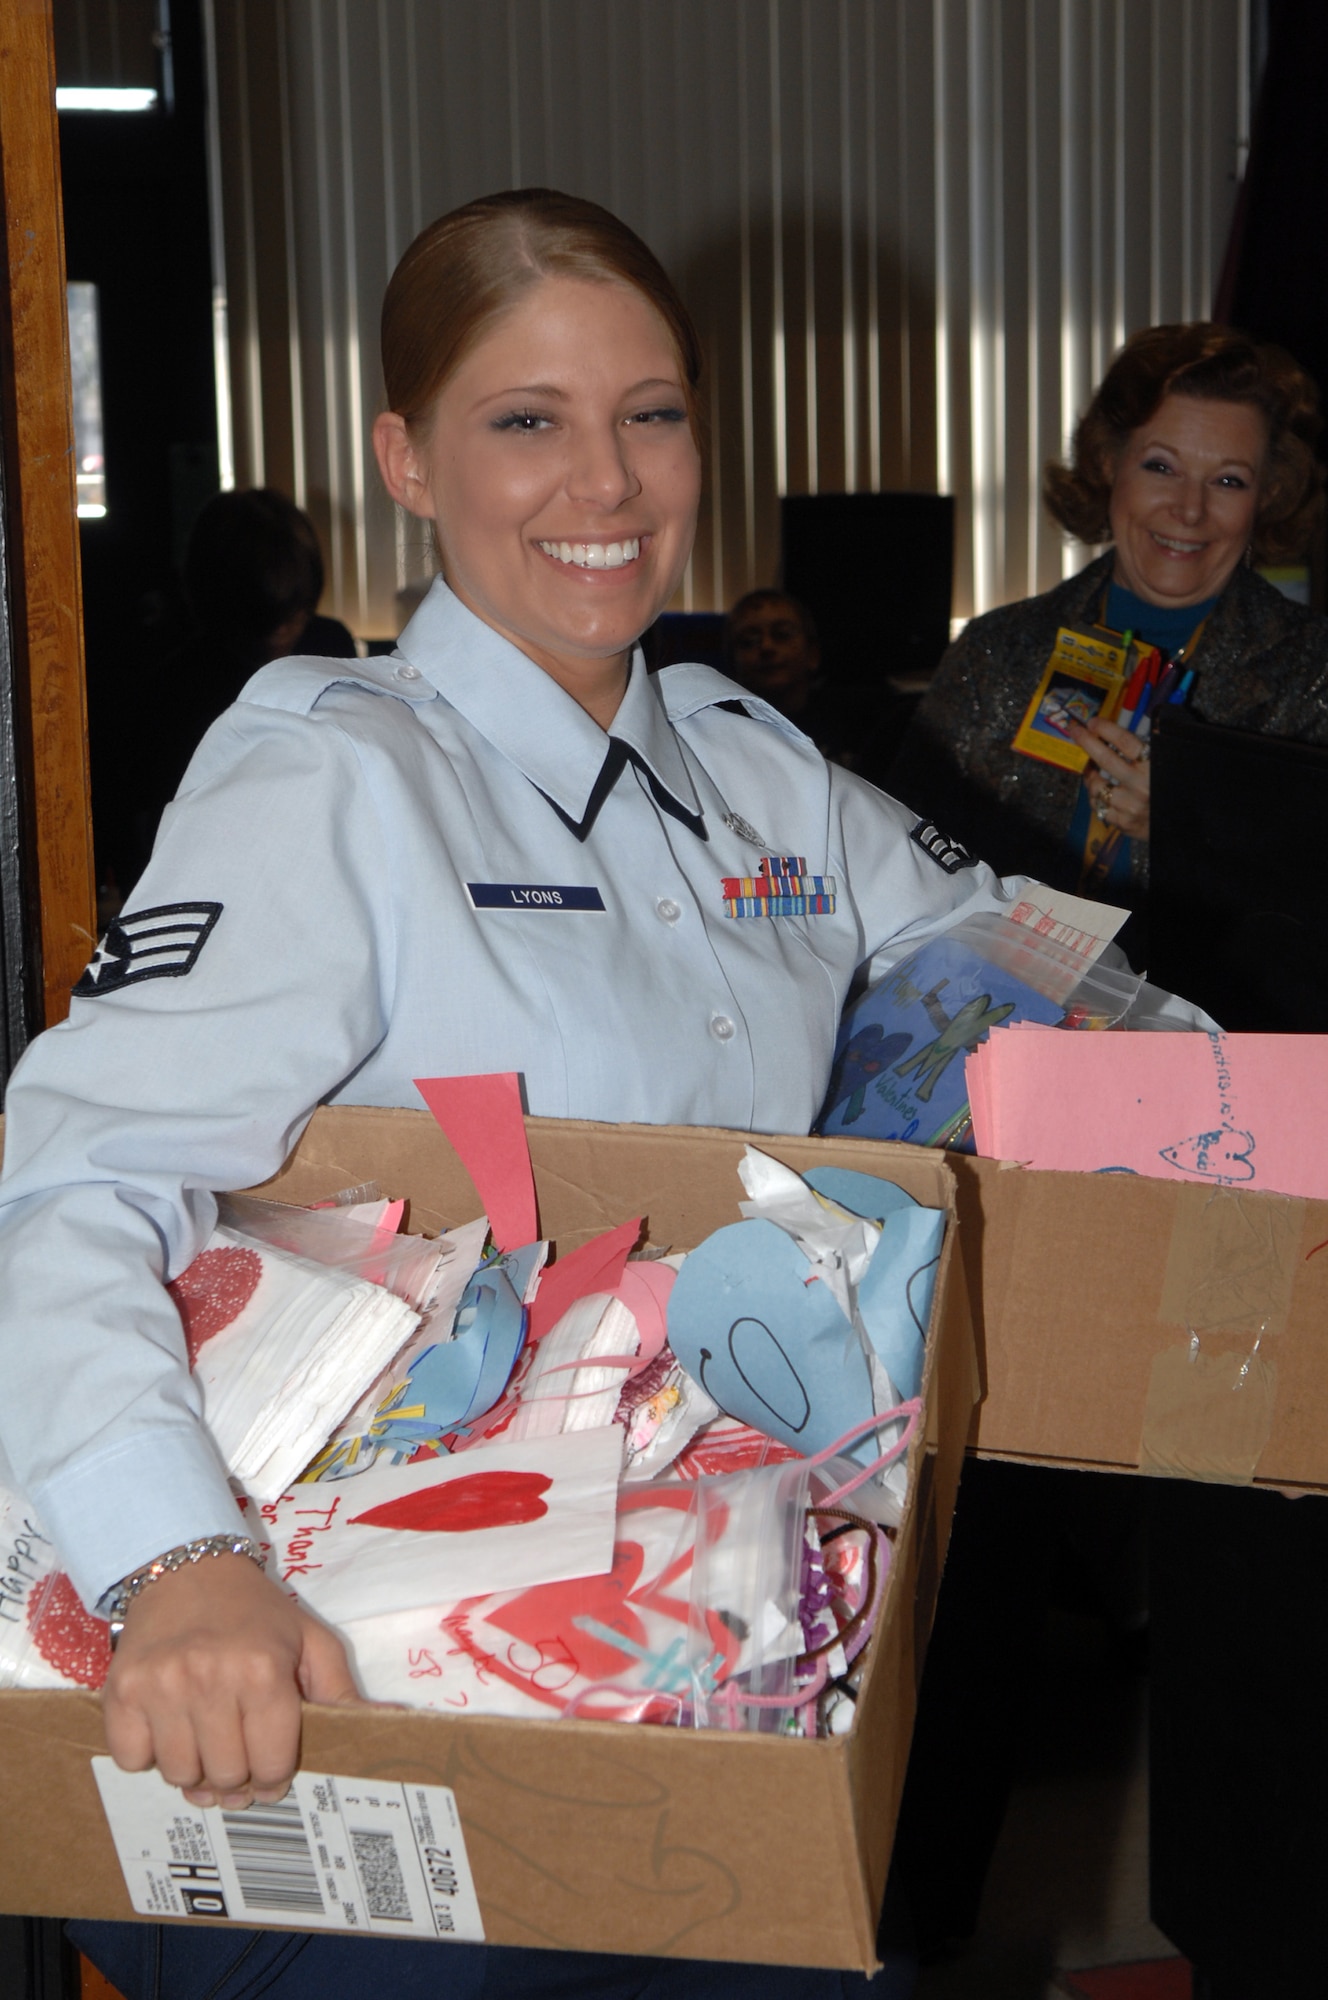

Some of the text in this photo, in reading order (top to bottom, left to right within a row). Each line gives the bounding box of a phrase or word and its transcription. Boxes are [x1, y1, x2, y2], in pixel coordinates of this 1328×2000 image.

[511, 890, 563, 905] LYONS
[260, 1495, 295, 1526] for
[282, 1496, 341, 1582] Thank
[424, 1847, 459, 1896] 40672
